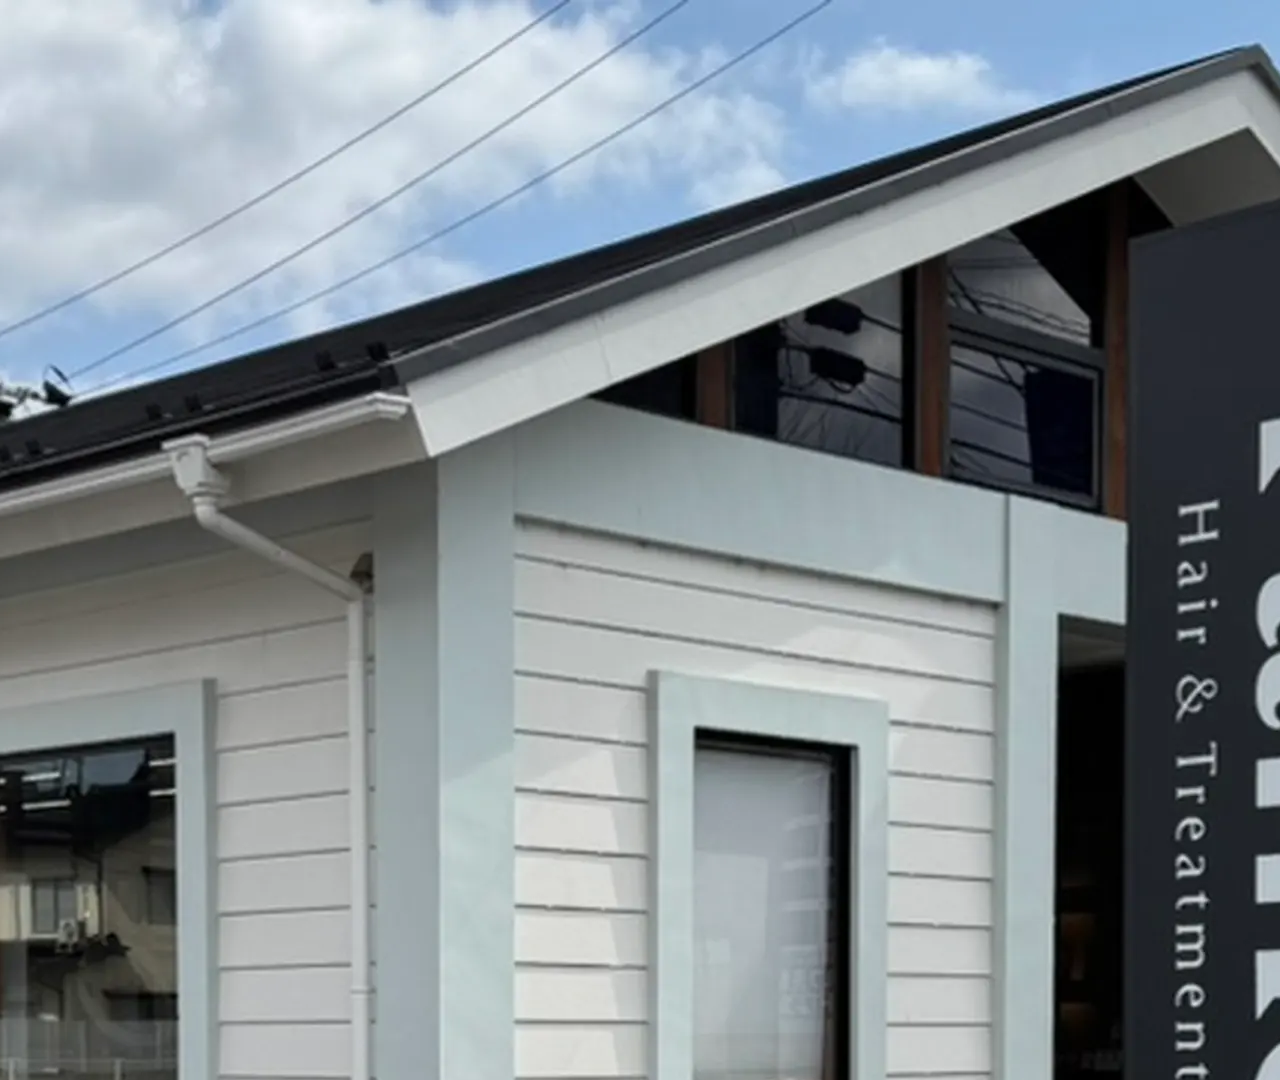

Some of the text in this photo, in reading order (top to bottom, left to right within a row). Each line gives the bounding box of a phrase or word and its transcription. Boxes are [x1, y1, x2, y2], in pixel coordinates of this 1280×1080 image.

[1175, 500, 1220, 1080] Hair & Treatment
